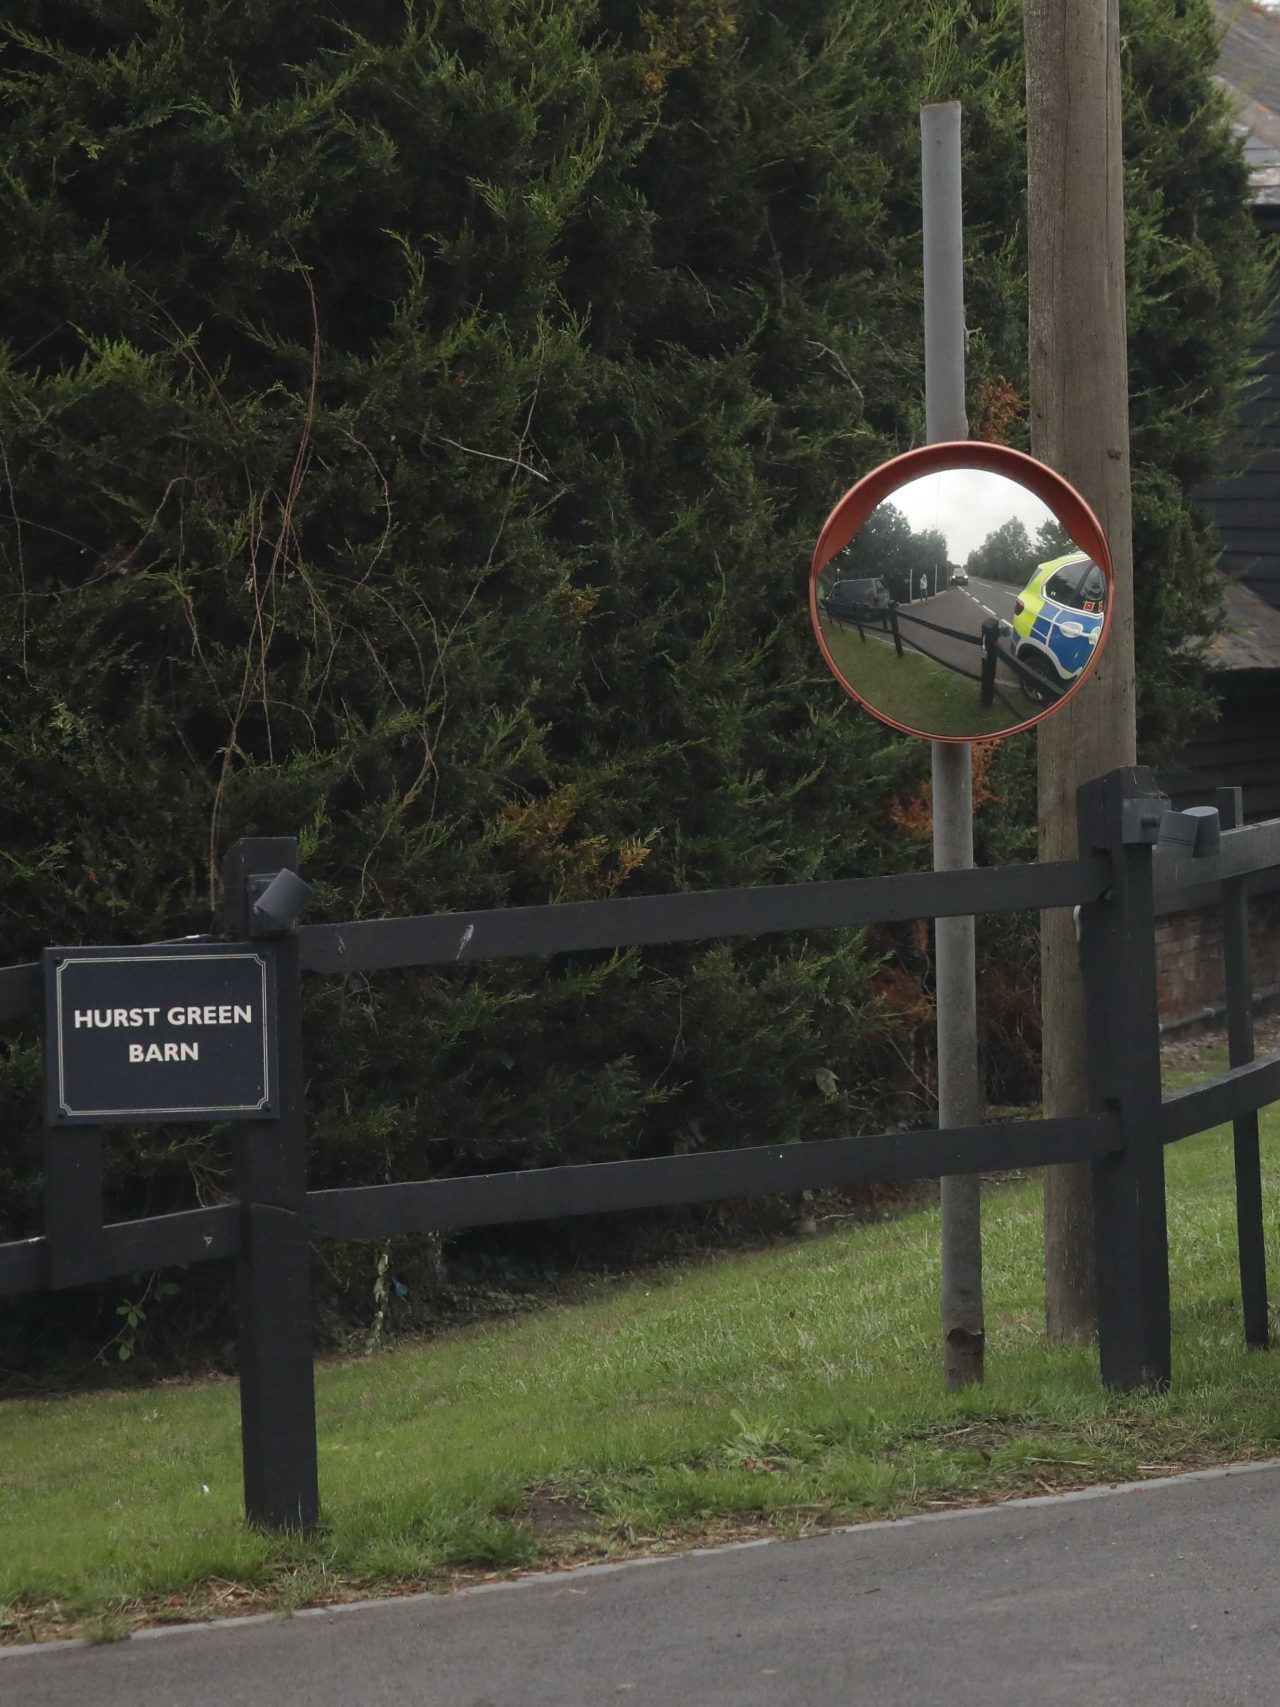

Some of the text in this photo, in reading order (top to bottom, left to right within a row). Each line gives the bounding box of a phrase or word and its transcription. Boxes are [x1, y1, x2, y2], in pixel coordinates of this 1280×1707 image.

[74, 1004, 252, 1029] HURST GREEN
[128, 1042, 199, 1063] BARN
